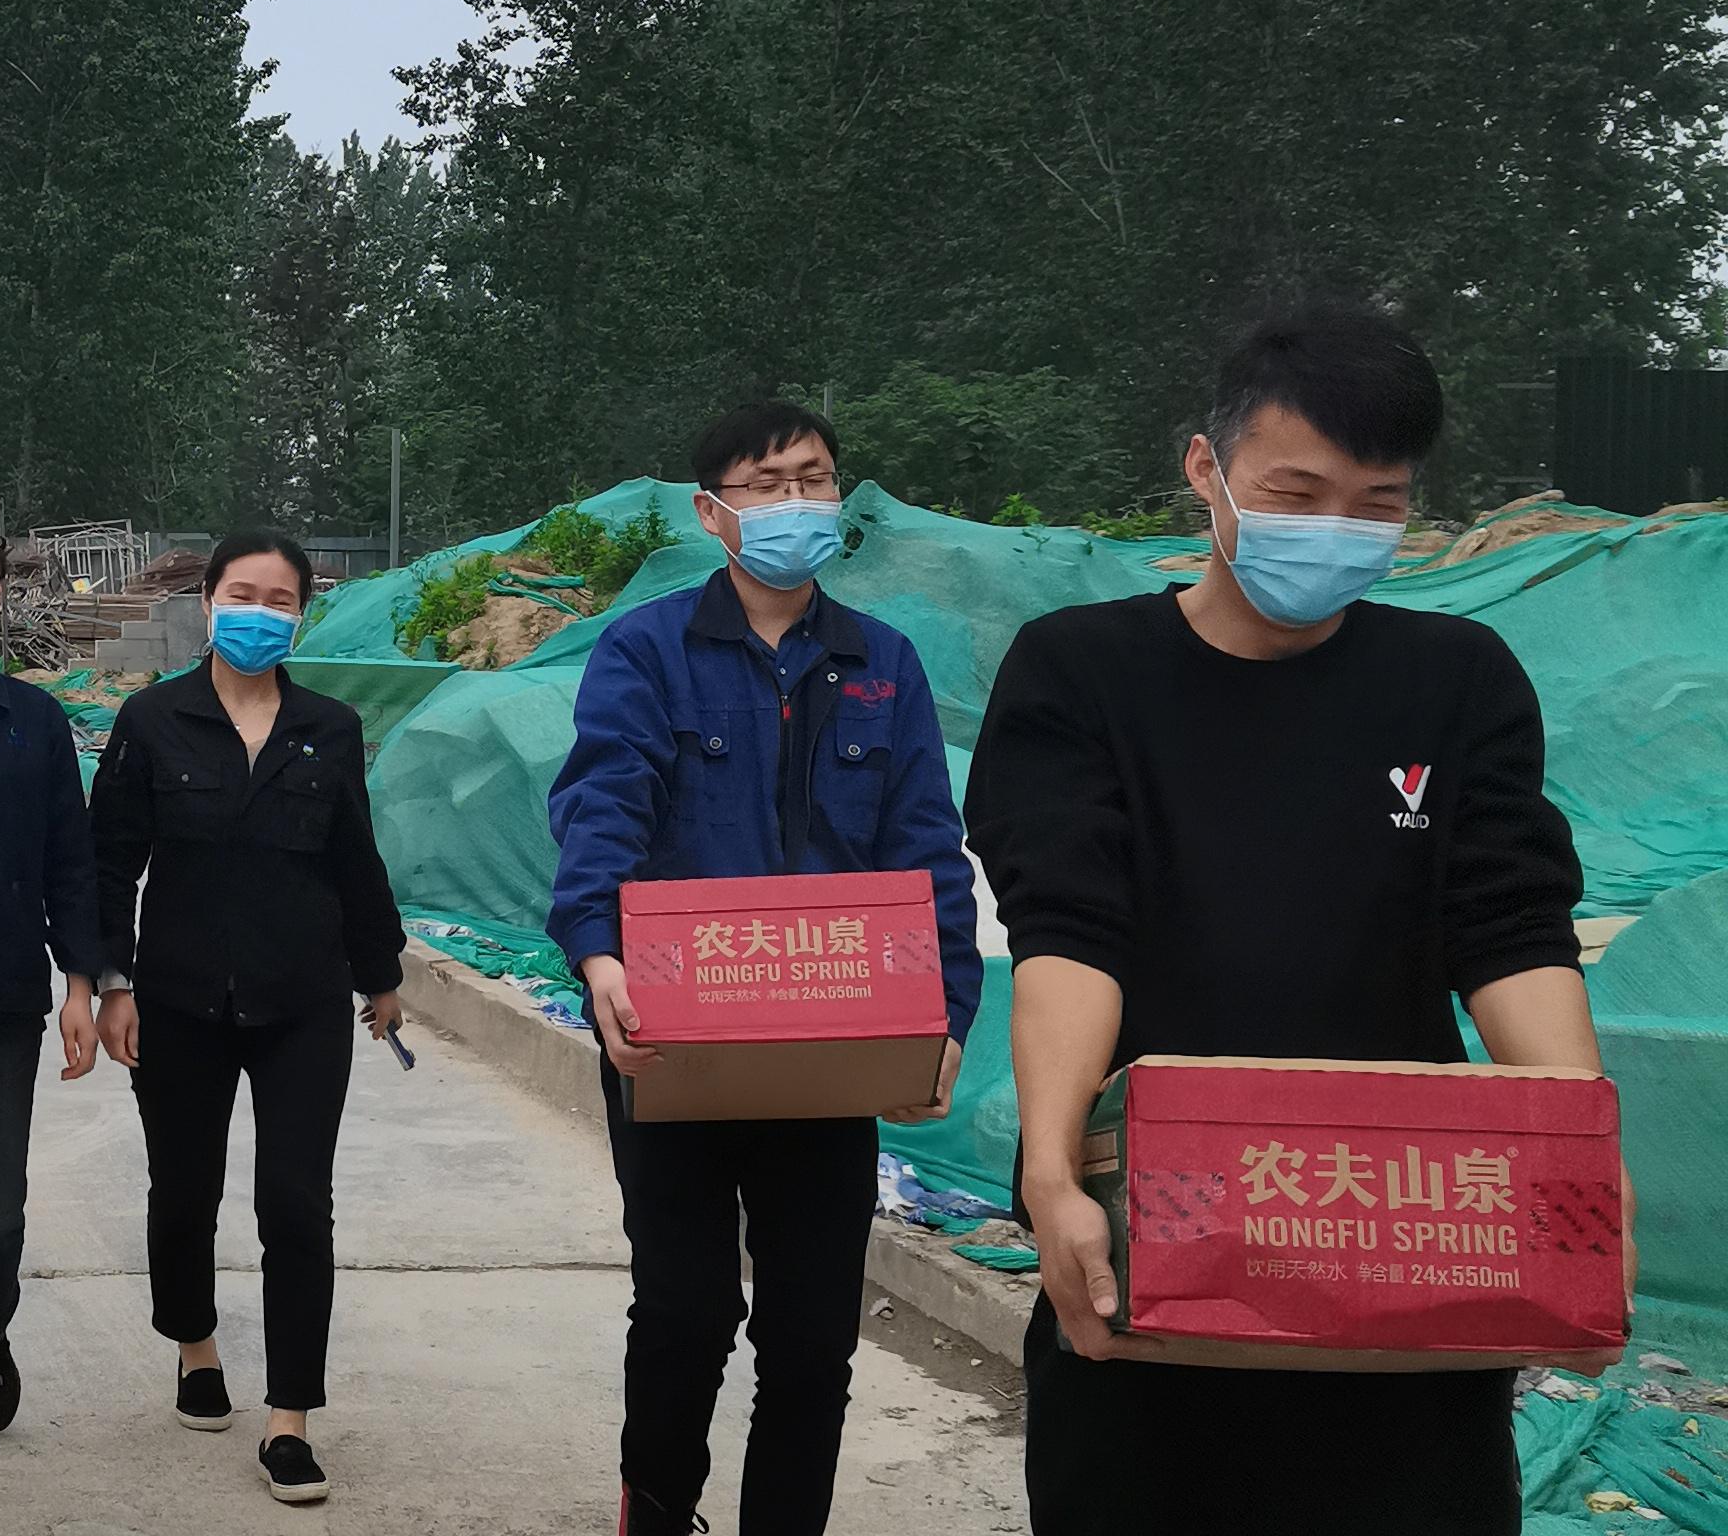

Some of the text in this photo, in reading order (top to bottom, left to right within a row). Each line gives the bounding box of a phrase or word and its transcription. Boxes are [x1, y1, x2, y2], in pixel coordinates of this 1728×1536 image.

[692, 917, 870, 961] 农夫山泉
[695, 960, 871, 985] NONGFU SPRING
[1239, 1140, 1519, 1214] 农夫山泉
[1244, 1215, 1518, 1256] NONGFU SPRING
[1246, 1258, 1348, 1282] 饮用天然水
